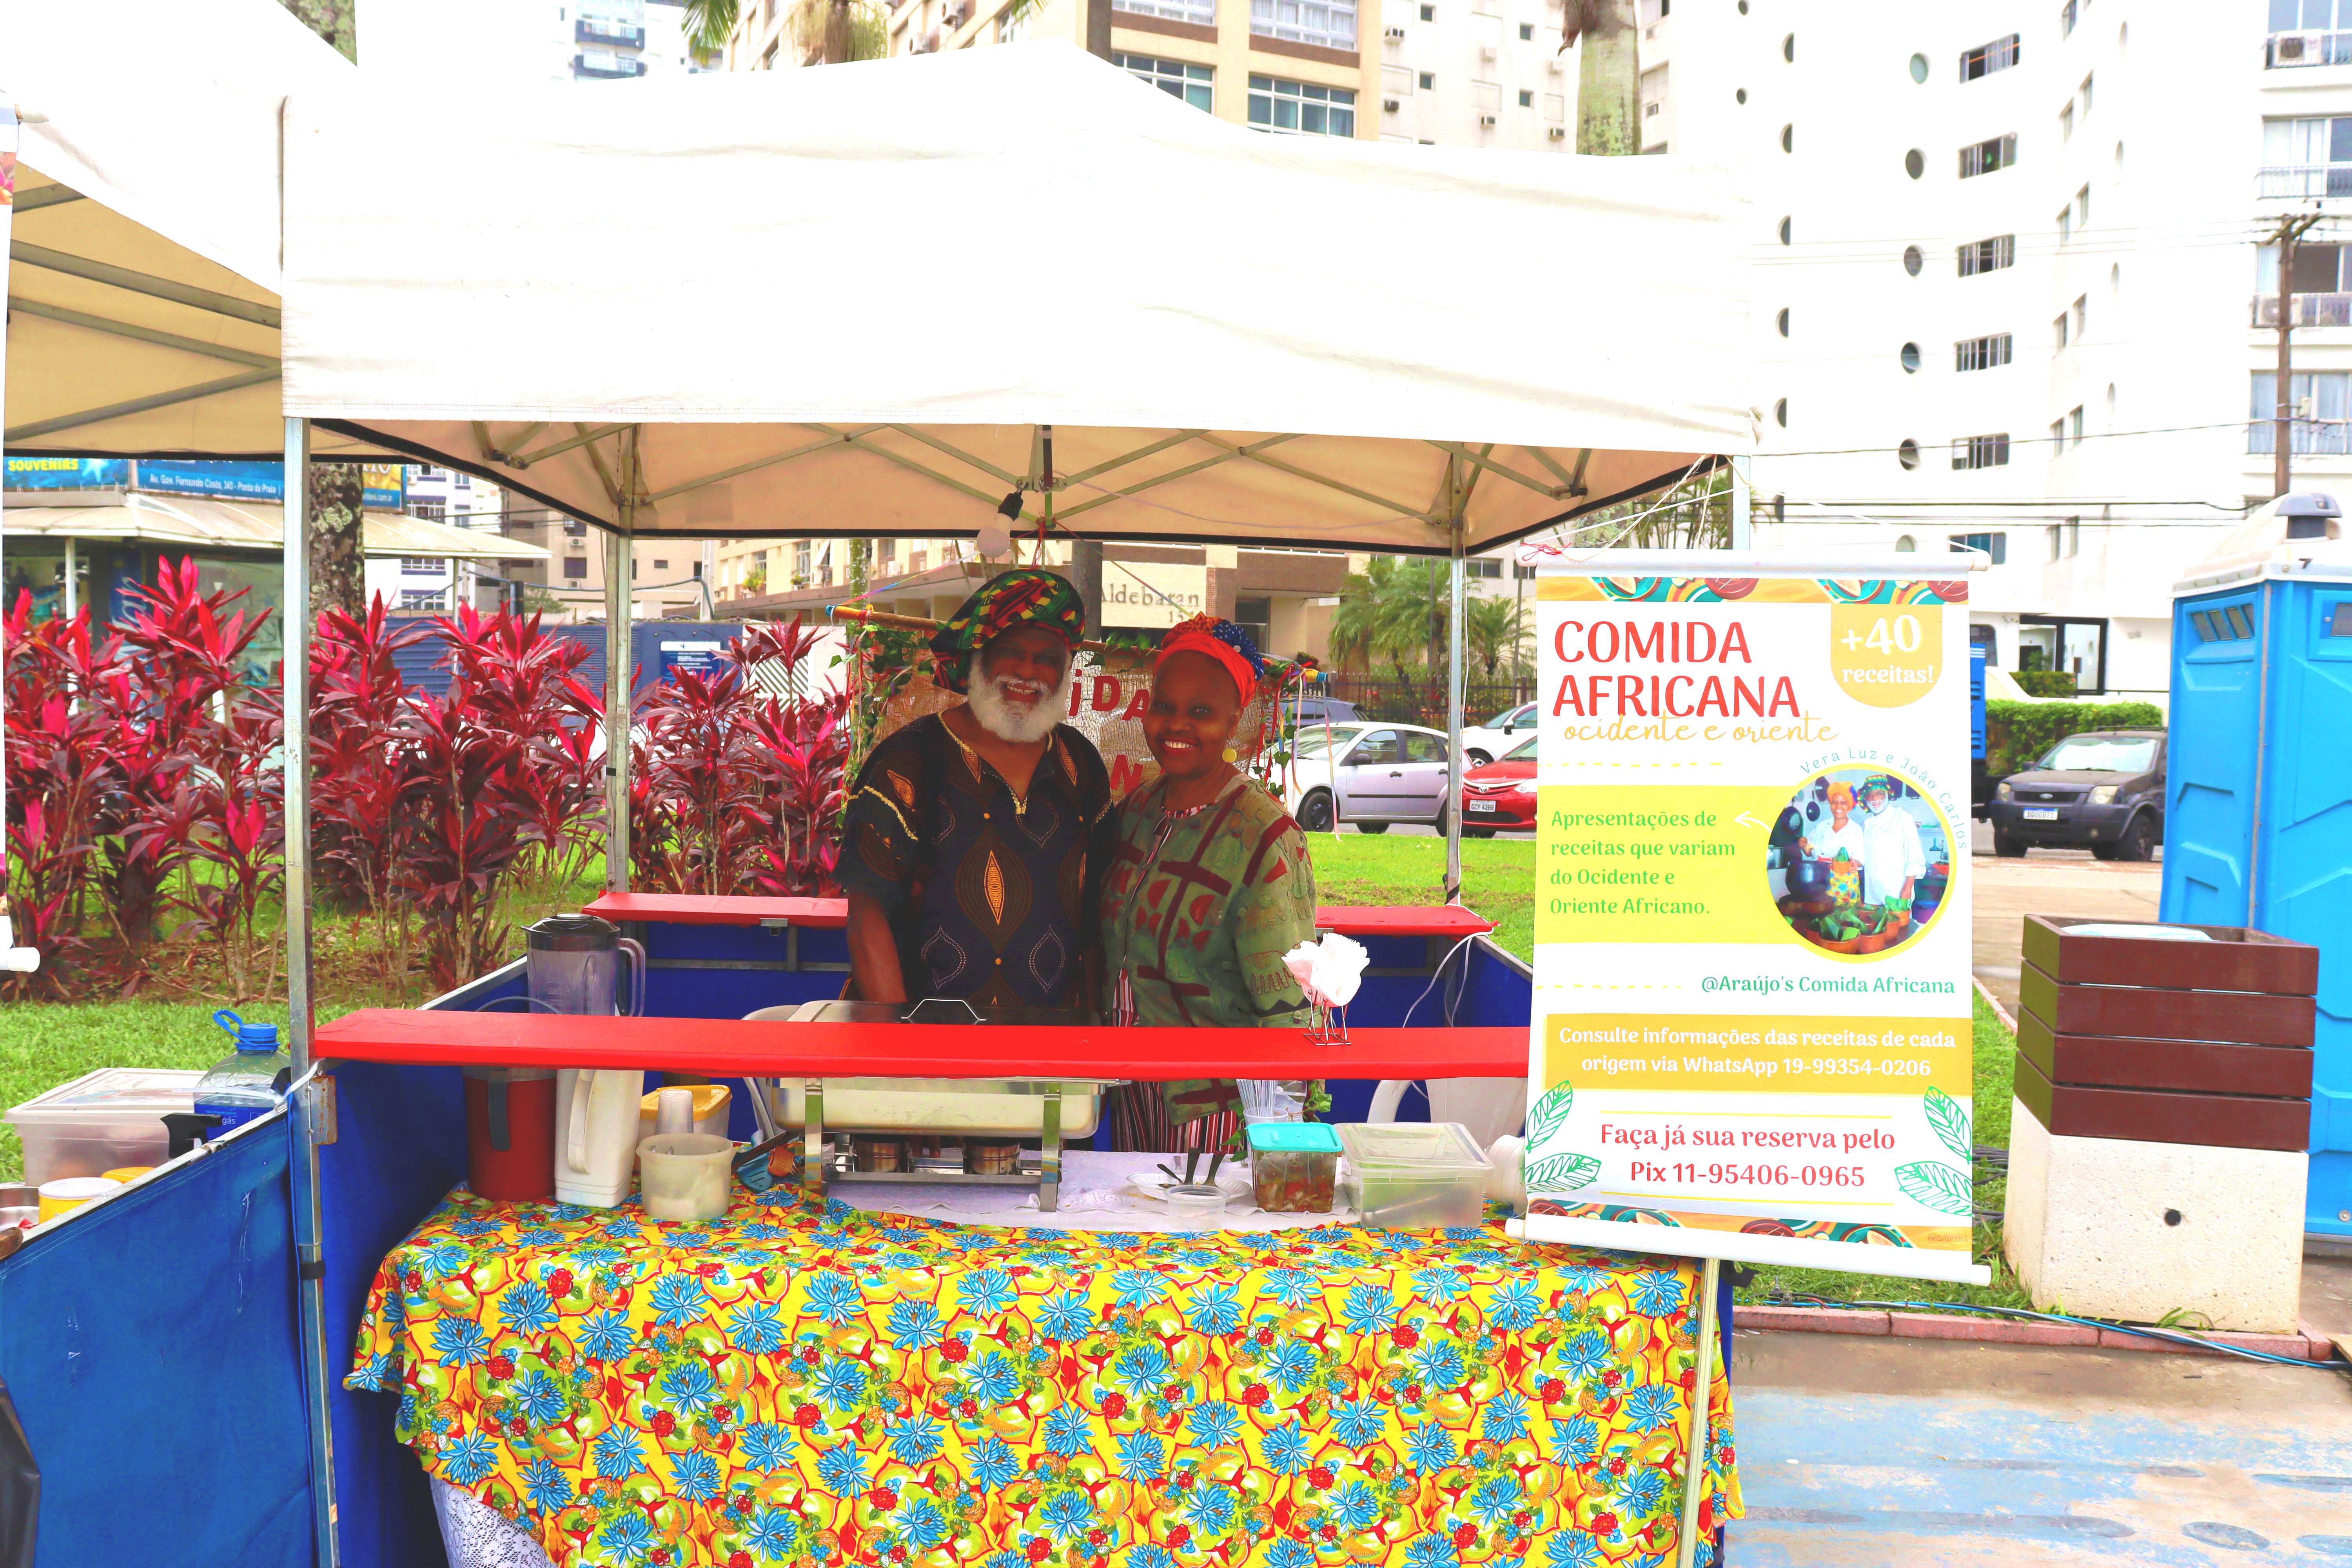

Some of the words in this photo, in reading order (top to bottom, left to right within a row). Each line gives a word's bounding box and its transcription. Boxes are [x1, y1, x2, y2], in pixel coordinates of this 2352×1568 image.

[8, 459, 79, 471] SOUVENIRS
[150, 473, 159, 483] Av.
[160, 474, 174, 485] Gov.
[175, 475, 203, 487] Fernando
[238, 481, 253, 492] Ponta
[254, 483, 261, 492] da
[262, 483, 276, 494] Praia
[1555, 621, 1752, 663] COMIDA
[1840, 615, 1923, 656] +40
[1842, 665, 1934, 685] receitas!
[1553, 675, 1801, 718] AFRICANA
[1565, 709, 1697, 741] ocidente
[1704, 723, 1728, 741] e
[1733, 710, 1839, 743] oriente
[1800, 752, 1840, 774] Vera
[1849, 747, 1877, 760] Luz
[1886, 754, 1894, 763] e
[1900, 757, 1936, 789] João
[1939, 792, 1967, 849] Carlos
[1551, 811, 1691, 830] Apresentações
[1695, 810, 1717, 827] de
[1551, 840, 1626, 856] receitas
[1630, 842, 1664, 860] que
[1668, 841, 1735, 856] variam
[1550, 869, 1573, 885] do
[1577, 869, 1661, 885] Ocidente
[1664, 873, 1675, 885] e
[1550, 898, 1618, 915] Oriente
[1622, 898, 1710, 915] Africano.
[1702, 975, 1795, 995] @Araújo's
[1799, 977, 1868, 993] Comida
[1873, 977, 1955, 994] Africana
[1560, 1027, 1639, 1044] Consulte
[1643, 1027, 1760, 1049] informações
[1764, 1029, 1797, 1045] das
[1802, 1031, 1877, 1047] receitas
[1882, 1031, 1905, 1047] de
[1909, 1031, 1956, 1048] cada
[1582, 1057, 1646, 1076] origem
[1651, 1057, 1678, 1072] via
[1682, 1057, 1778, 1077] WhatsApp
[1782, 1058, 1931, 1076] 19-99354-0206
[222, 1116, 236, 1125] gás
[1601, 1125, 1657, 1149] Faça
[1662, 1124, 1686, 1151] já
[1692, 1130, 1735, 1147] sua
[1742, 1131, 1836, 1149] reserva
[1844, 1129, 1895, 1154] pelo
[1631, 1162, 1666, 1182] Pix
[1673, 1163, 1865, 1187] 11-95406-0965
